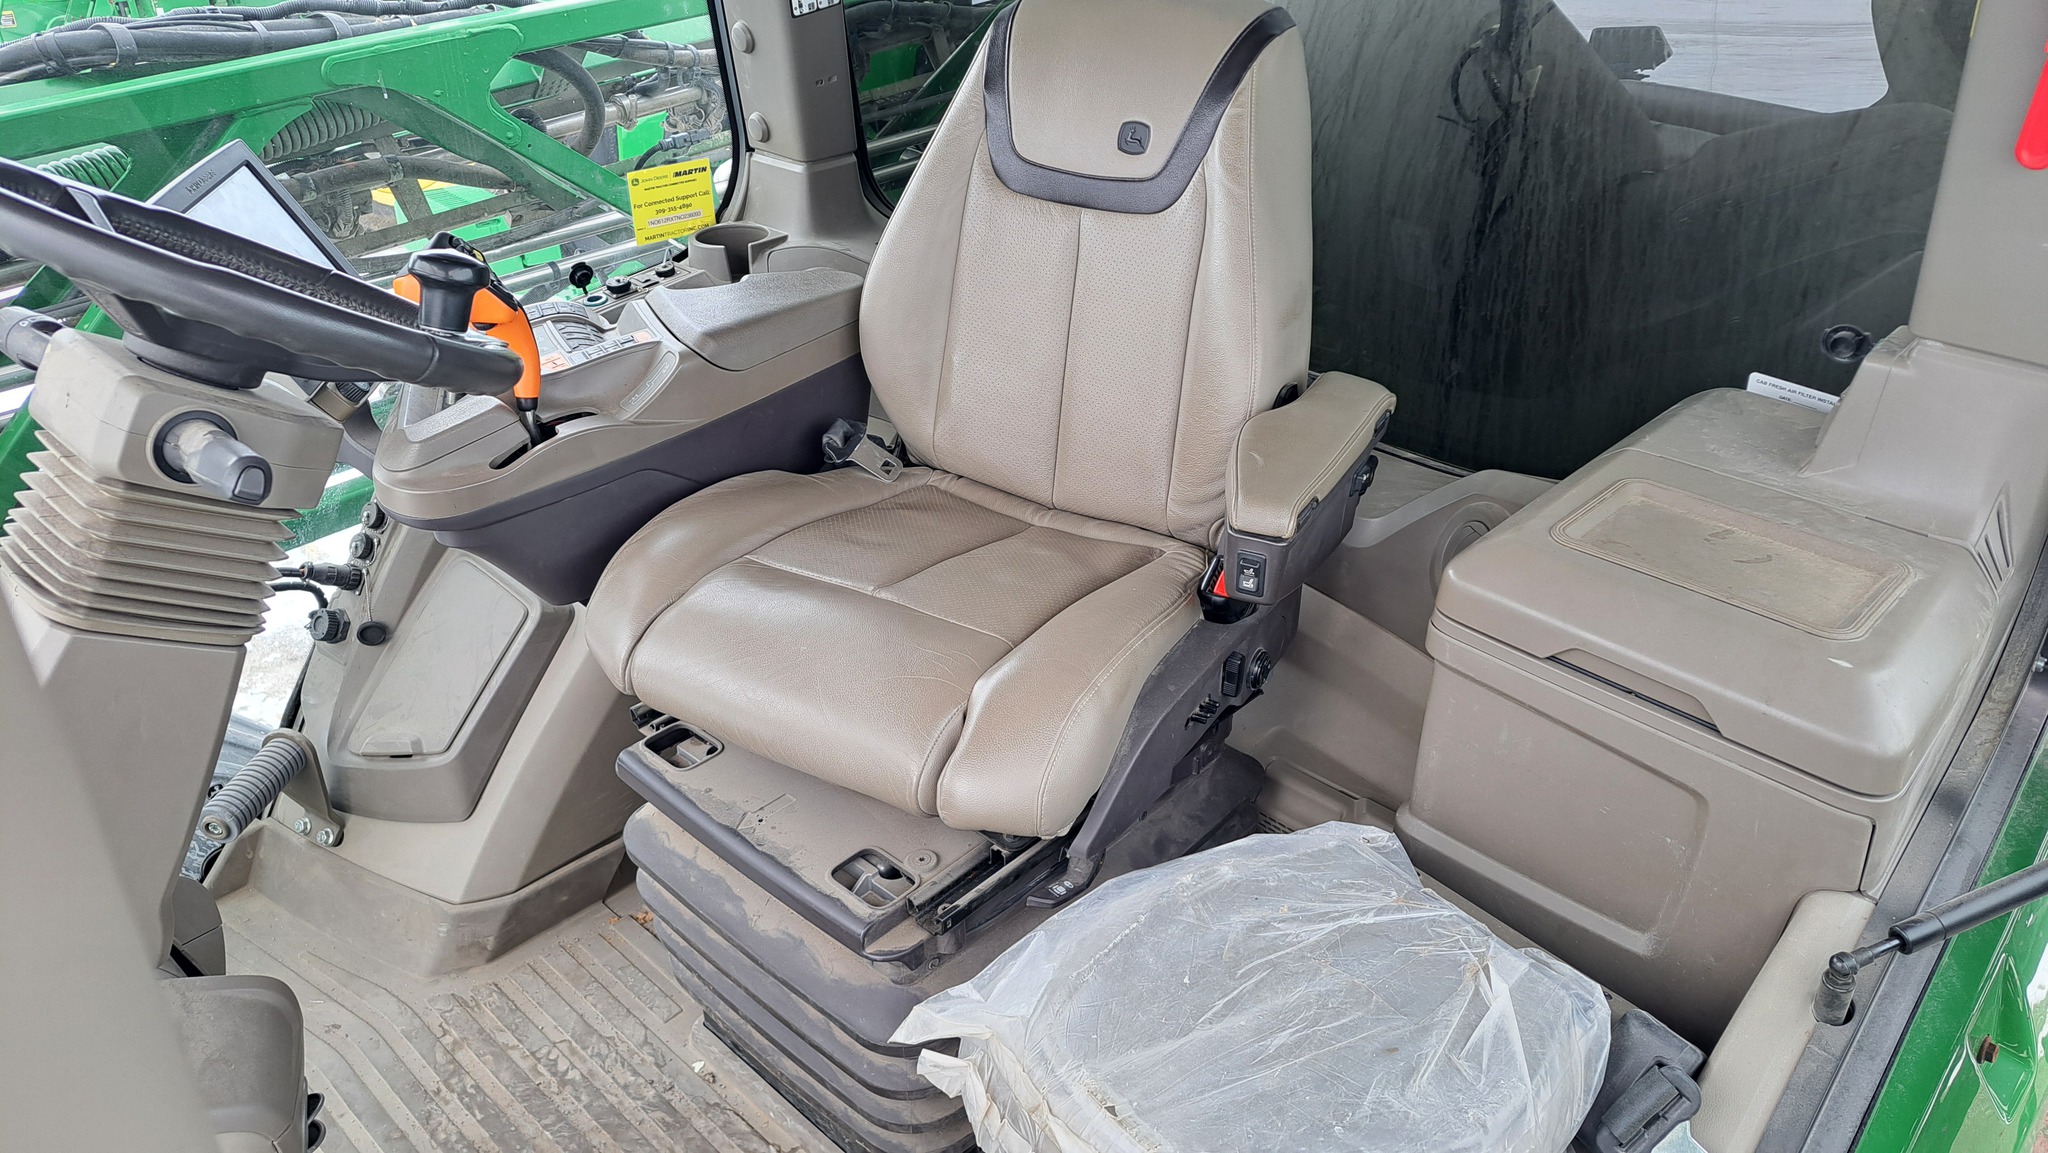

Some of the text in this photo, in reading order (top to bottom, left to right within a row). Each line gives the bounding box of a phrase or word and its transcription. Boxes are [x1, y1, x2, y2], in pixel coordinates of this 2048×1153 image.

[673, 166, 707, 178] MARTIN
[644, 196, 675, 208] Connected
[675, 192, 698, 202] Support
[655, 203, 693, 215] 309-315-4890
[644, 223, 710, 241] MARTINTRACTORINC.COM
[1768, 382, 1787, 391] FRESH
[1798, 391, 1817, 400] FILTER
